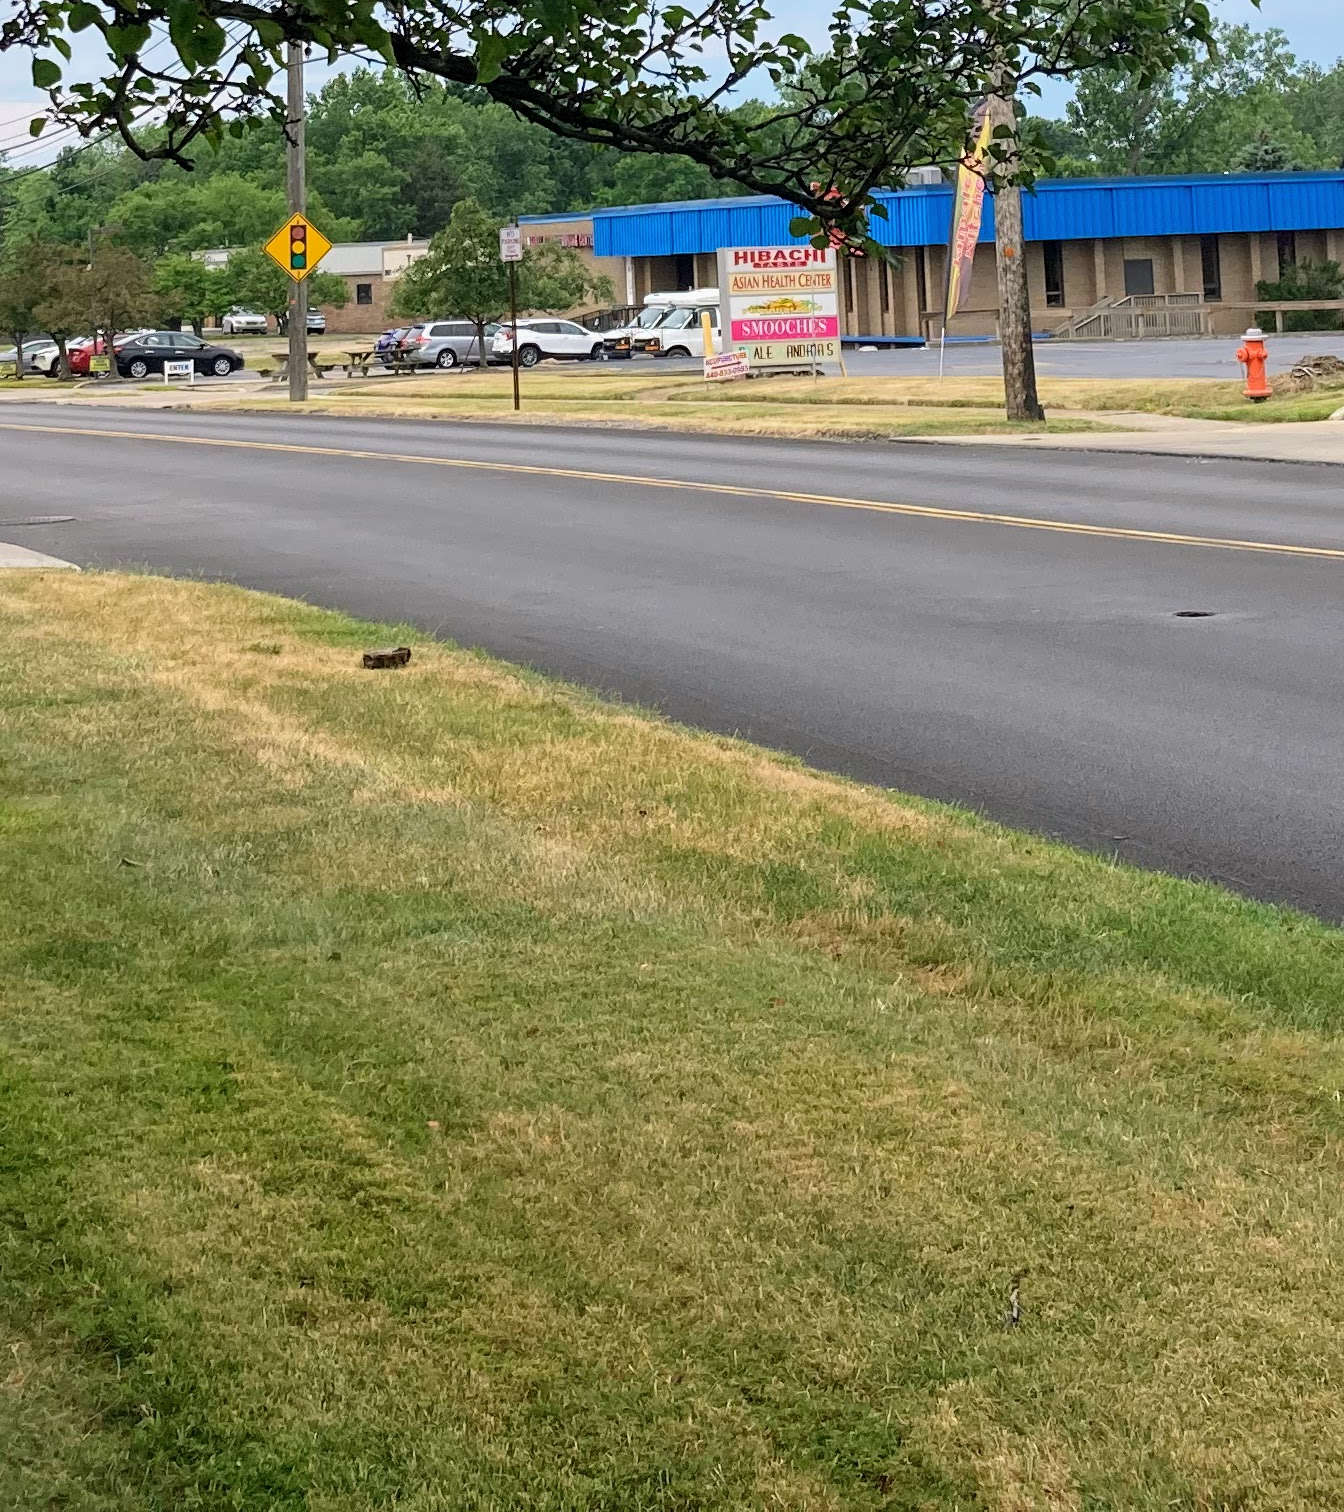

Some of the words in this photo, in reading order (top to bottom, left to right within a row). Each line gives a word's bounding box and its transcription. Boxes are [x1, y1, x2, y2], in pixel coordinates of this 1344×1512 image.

[733, 249, 826, 266] HIBACHI
[732, 275, 760, 289] ASIAN
[762, 274, 796, 289] HEALTH
[798, 272, 832, 288] CENTER
[741, 318, 827, 337] SMOOCHES
